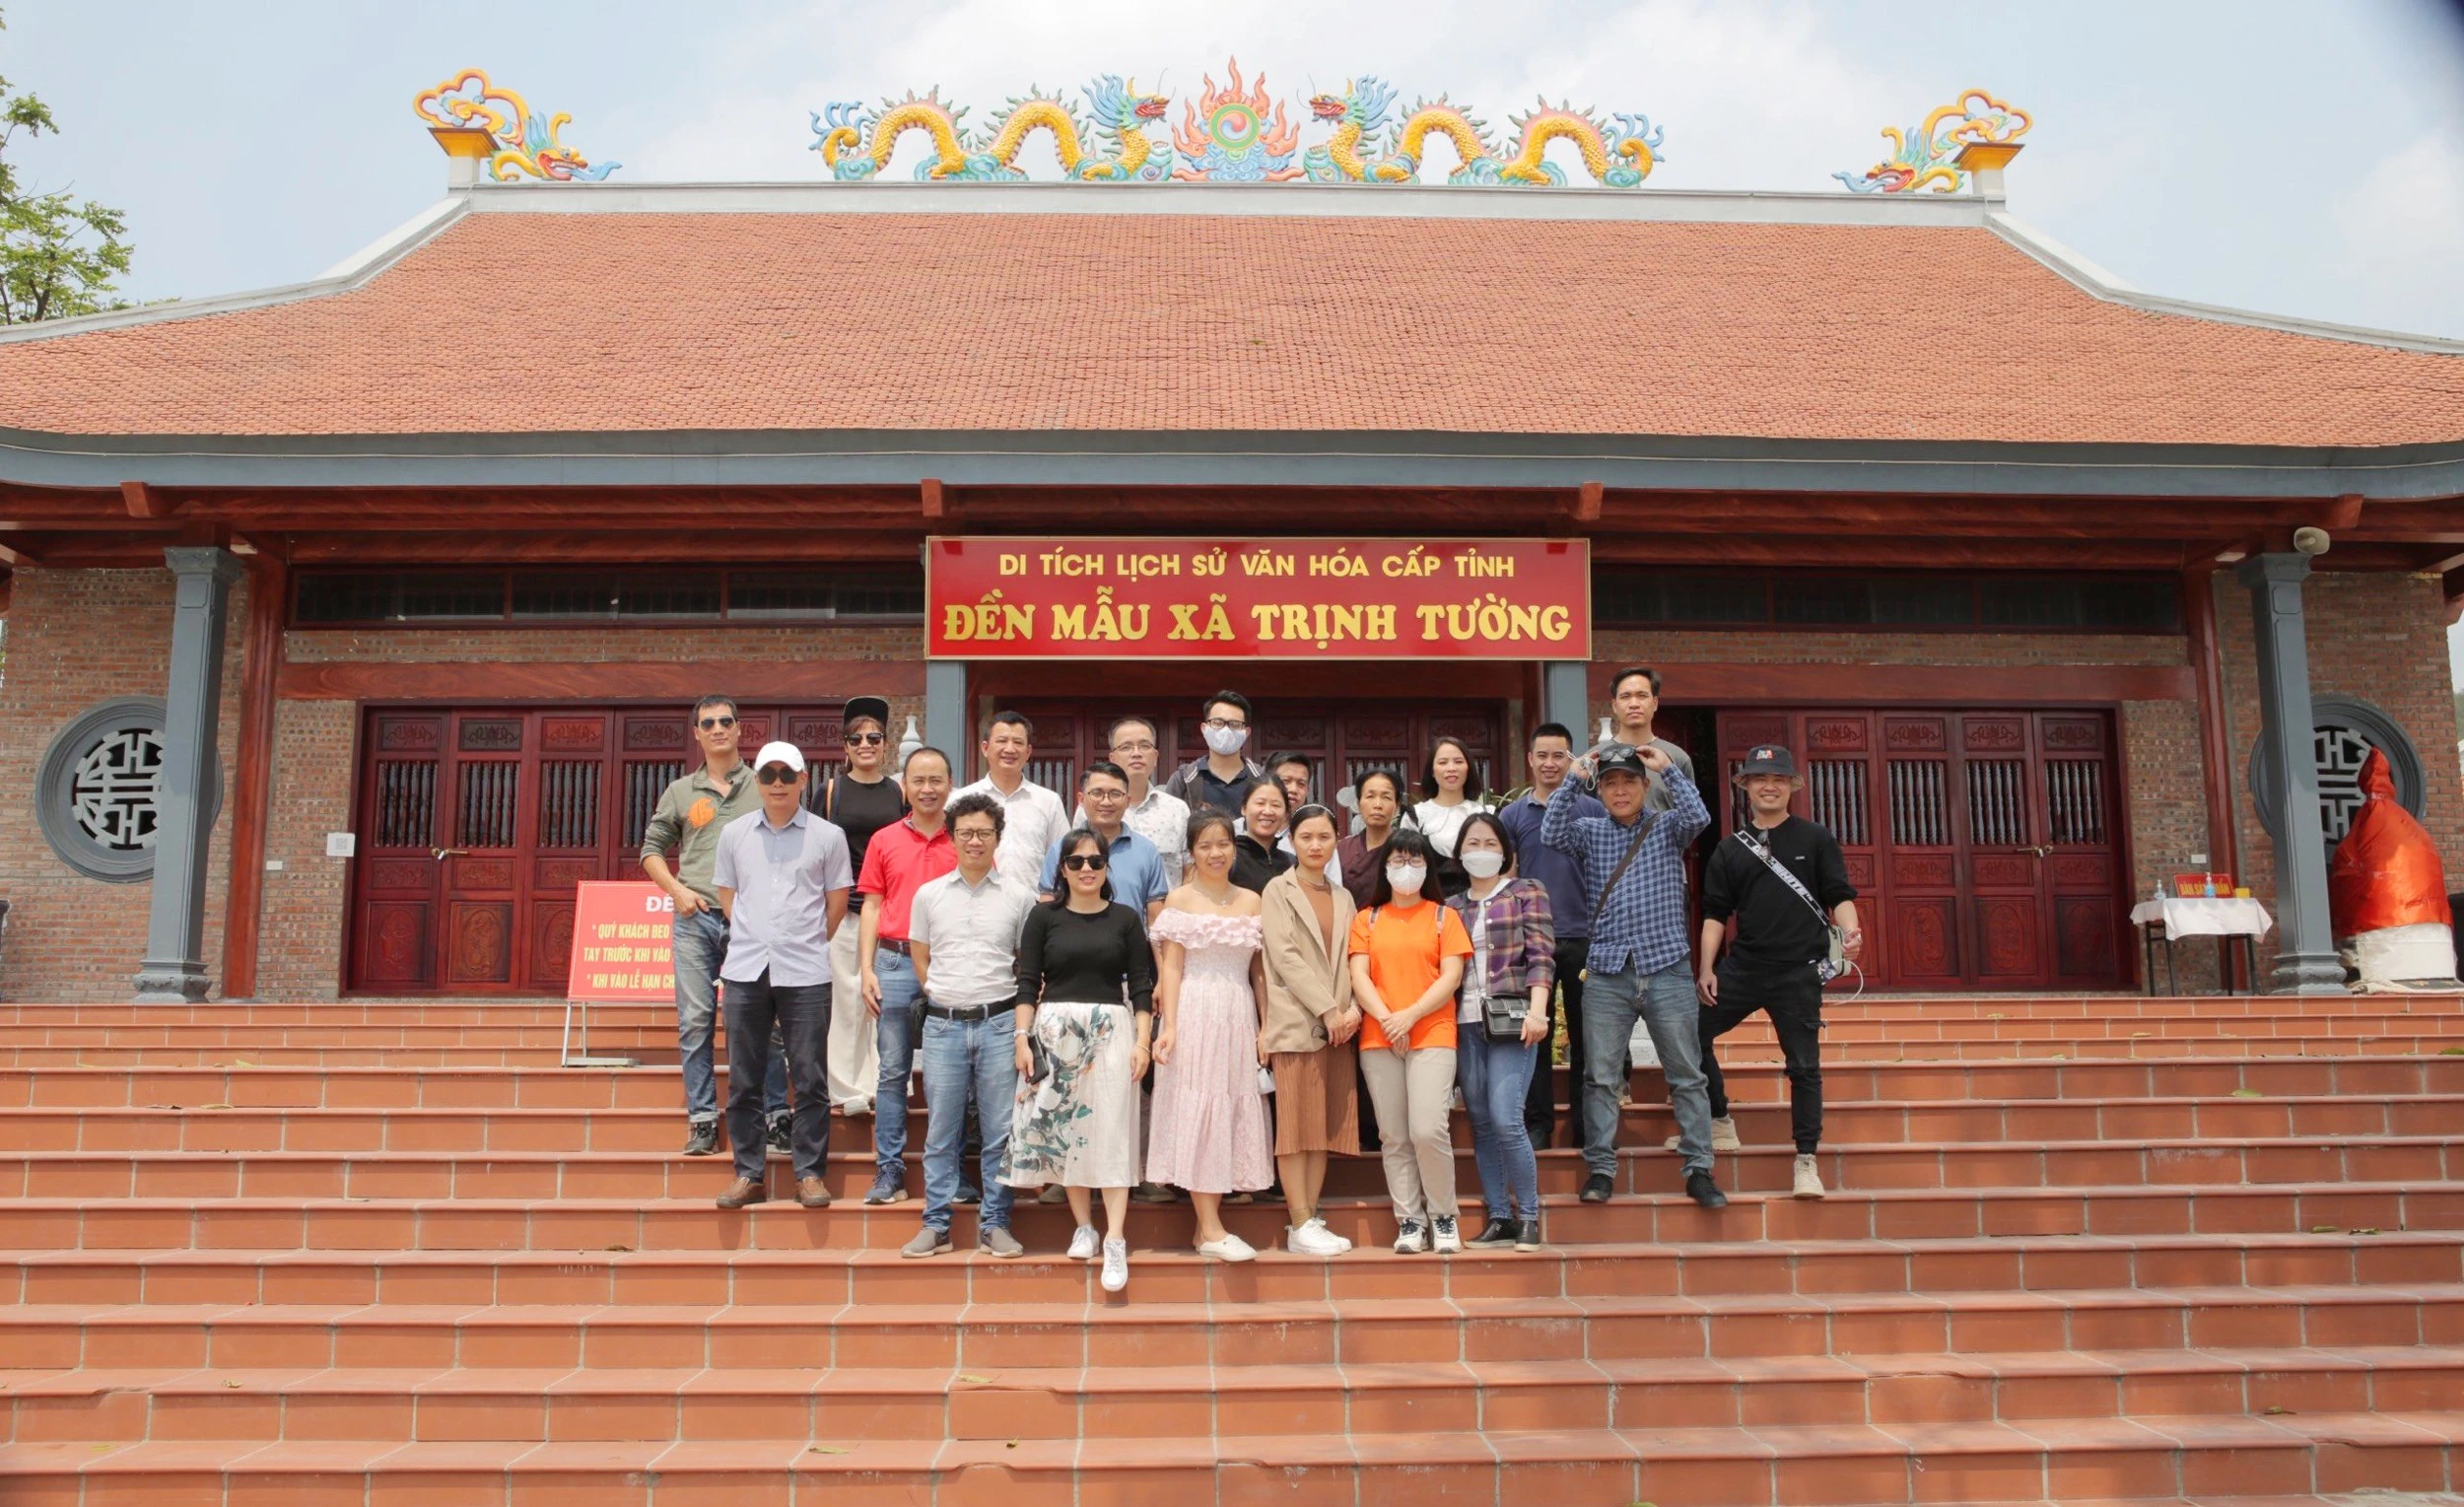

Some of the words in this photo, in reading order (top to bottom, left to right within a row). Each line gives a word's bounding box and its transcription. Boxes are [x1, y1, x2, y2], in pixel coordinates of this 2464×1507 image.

[999, 554, 1027, 576] DI
[1040, 546, 1104, 577] TÍCH
[1117, 554, 1180, 582] LỊCH
[1192, 547, 1227, 577] SỬ
[1240, 549, 1295, 577] VĂN
[1309, 547, 1370, 577] HÓA
[1382, 544, 1441, 578] CẤP
[1454, 547, 1514, 578] TỈNH
[943, 588, 1036, 641] ĐỀN
[1051, 585, 1151, 641] MẪU
[1167, 592, 1236, 641] XÃ
[1251, 603, 1398, 650] TRỊNH
[1415, 592, 1572, 642] TƯỜNG
[597, 920, 617, 940] QUÝ
[618, 921, 650, 939] KHÁCH
[583, 946, 601, 962] TAY
[634, 947, 650, 963] KHI
[652, 945, 671, 963] VÀO
[591, 973, 609, 989] KHI
[610, 970, 628, 989] VÀO
[642, 974, 661, 992] HẠN
[661, 974, 676, 990] CH
